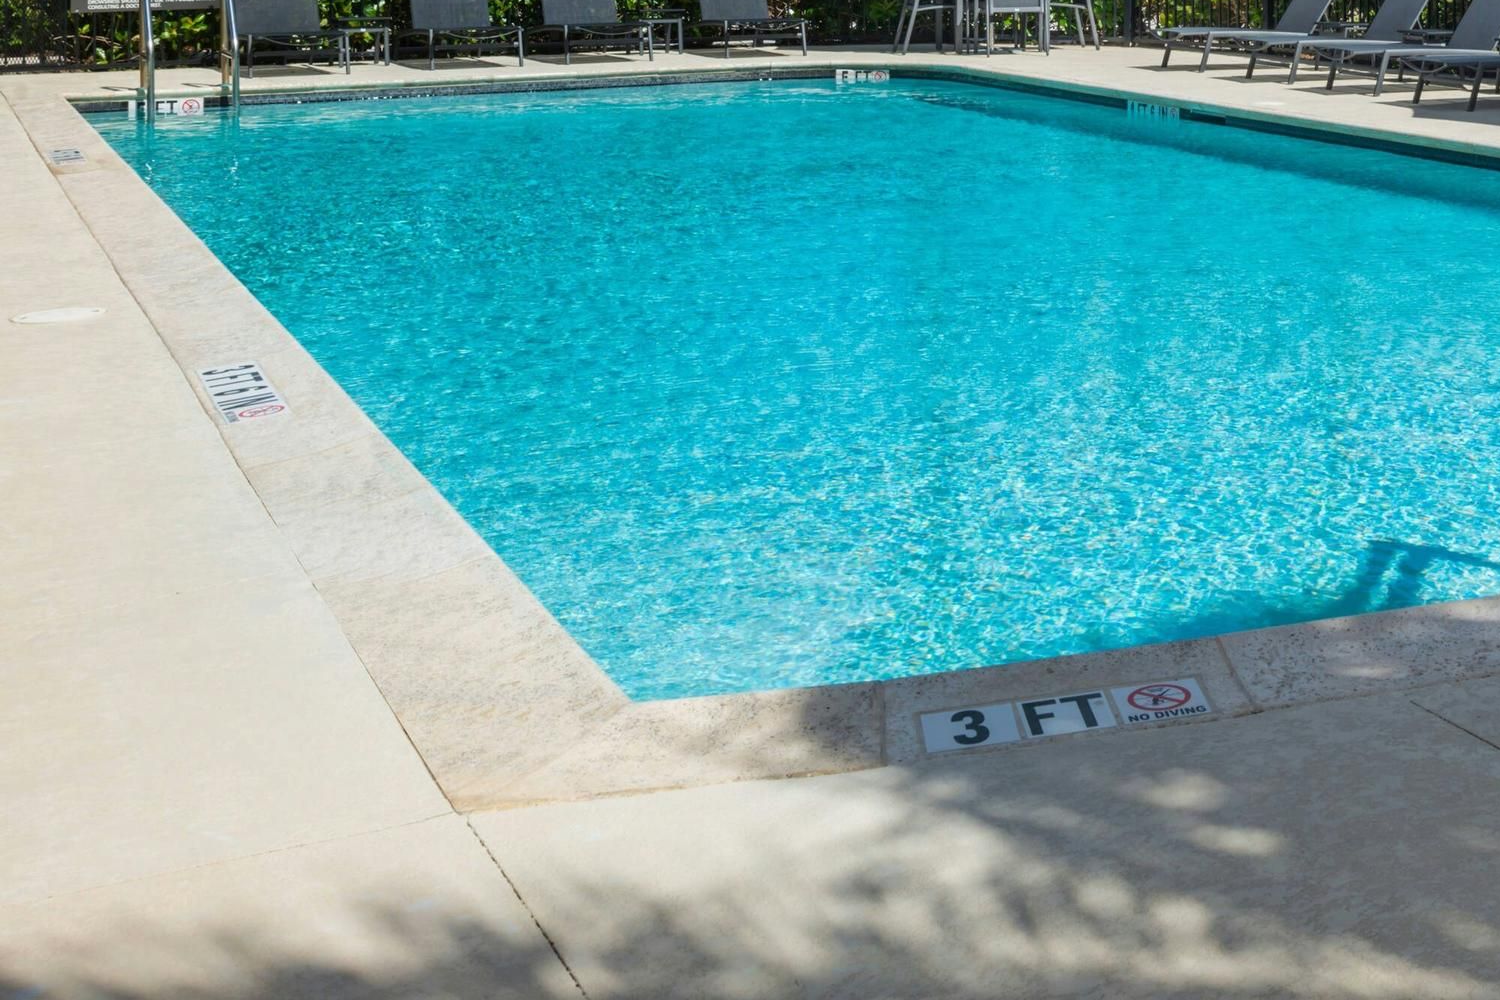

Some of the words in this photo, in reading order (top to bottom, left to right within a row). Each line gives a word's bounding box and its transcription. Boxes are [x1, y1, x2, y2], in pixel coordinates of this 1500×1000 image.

[950, 710, 991, 745] 3
[1021, 692, 1103, 735] FT
[1128, 713, 1150, 723] NO
[1154, 705, 1207, 719] DIVING
